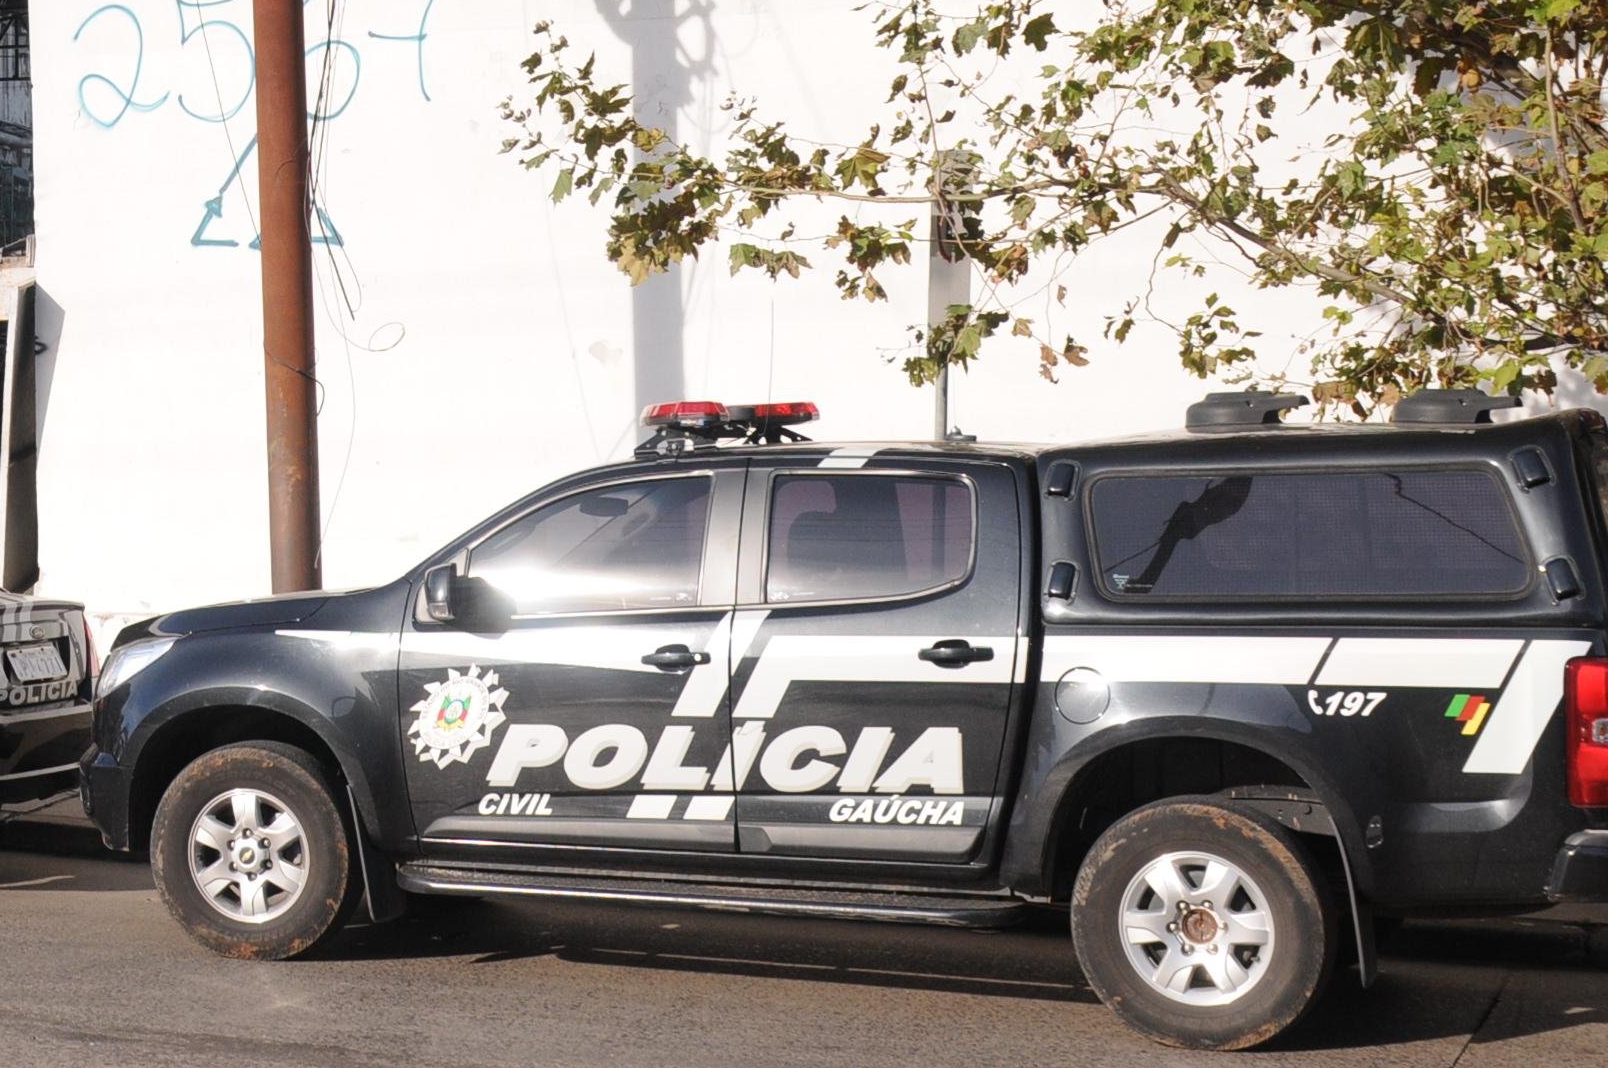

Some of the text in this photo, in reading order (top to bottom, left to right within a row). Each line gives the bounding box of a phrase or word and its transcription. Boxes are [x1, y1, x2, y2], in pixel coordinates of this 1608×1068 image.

[1324, 690, 1389, 717] 197
[485, 720, 965, 795] POLÍCIA
[478, 793, 554, 817] CIVIL
[828, 794, 966, 827] GAÚCHA
